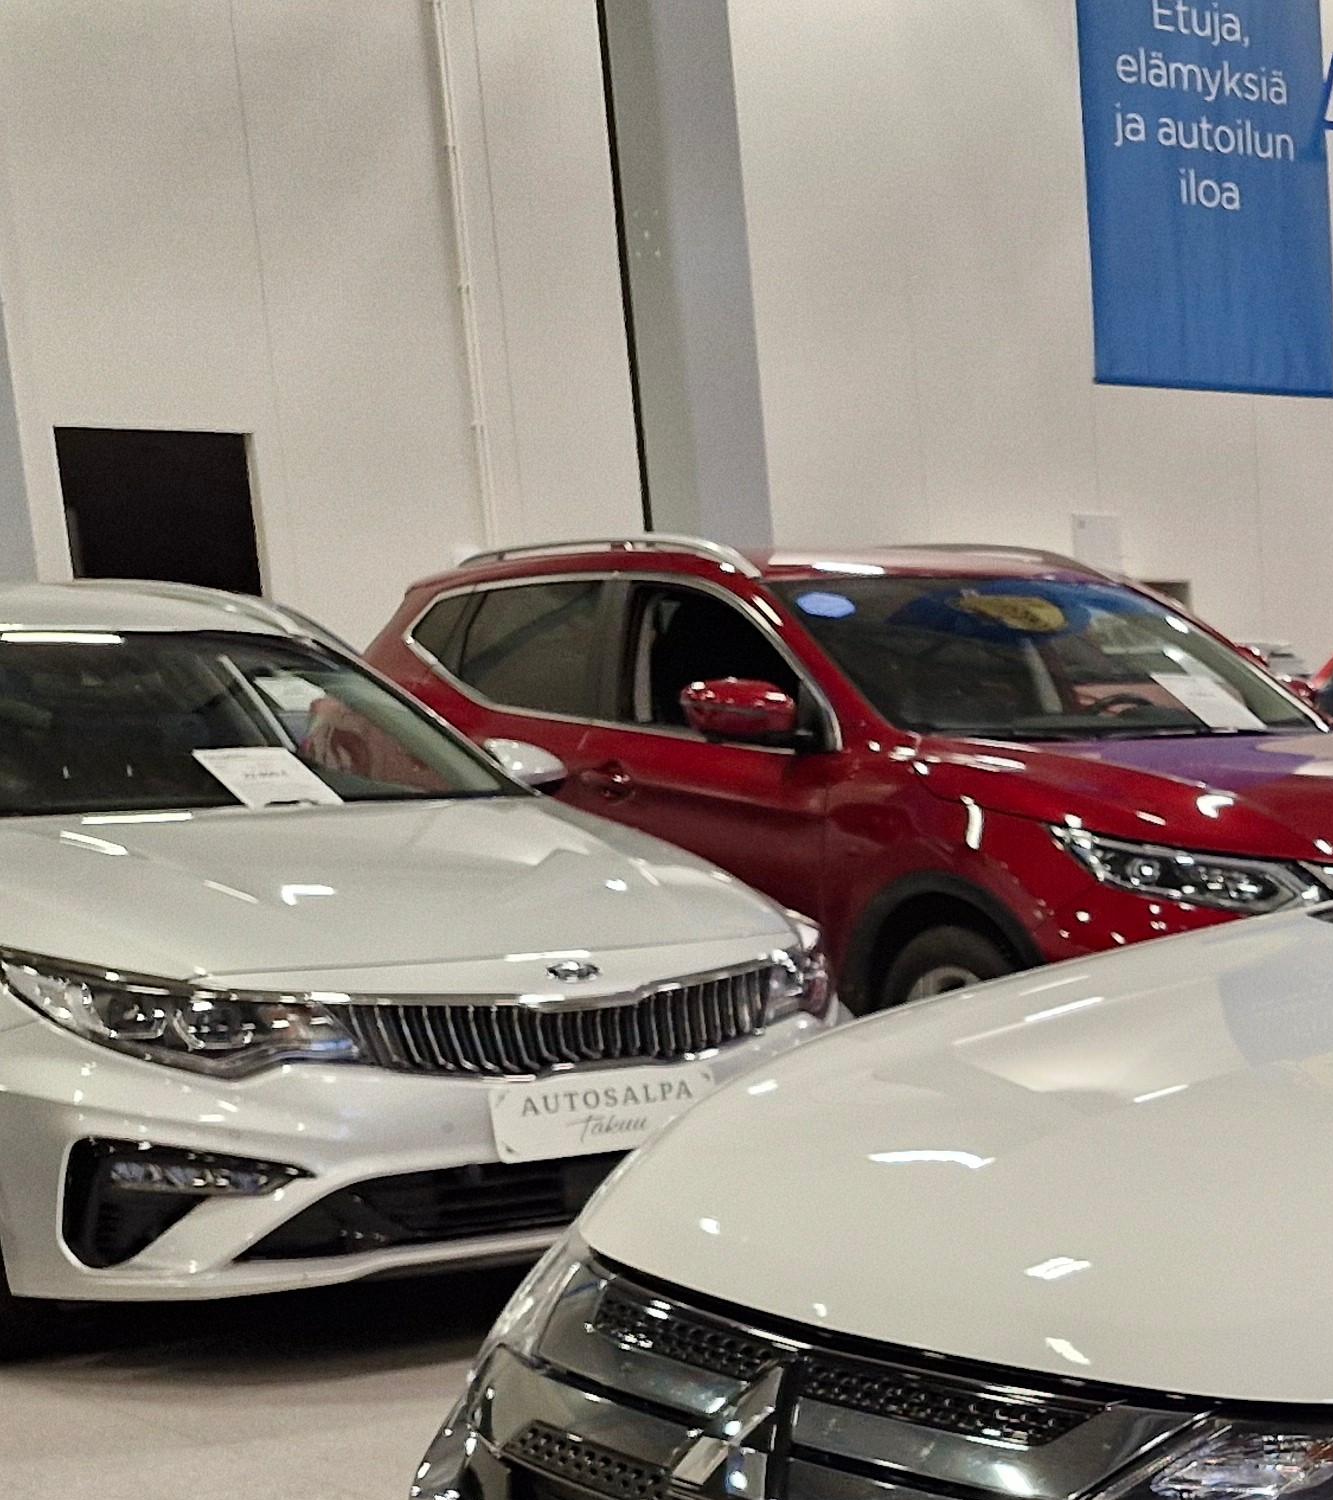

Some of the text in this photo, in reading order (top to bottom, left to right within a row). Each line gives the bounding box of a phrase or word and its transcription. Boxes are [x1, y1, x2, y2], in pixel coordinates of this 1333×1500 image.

[1153, 0, 1250, 47] Etuja,
[1116, 47, 1289, 105] elämyksiä
[1114, 103, 1296, 162] ja autoilun
[1179, 168, 1241, 210] iloa
[521, 1080, 693, 1117] AUTOSALPA
